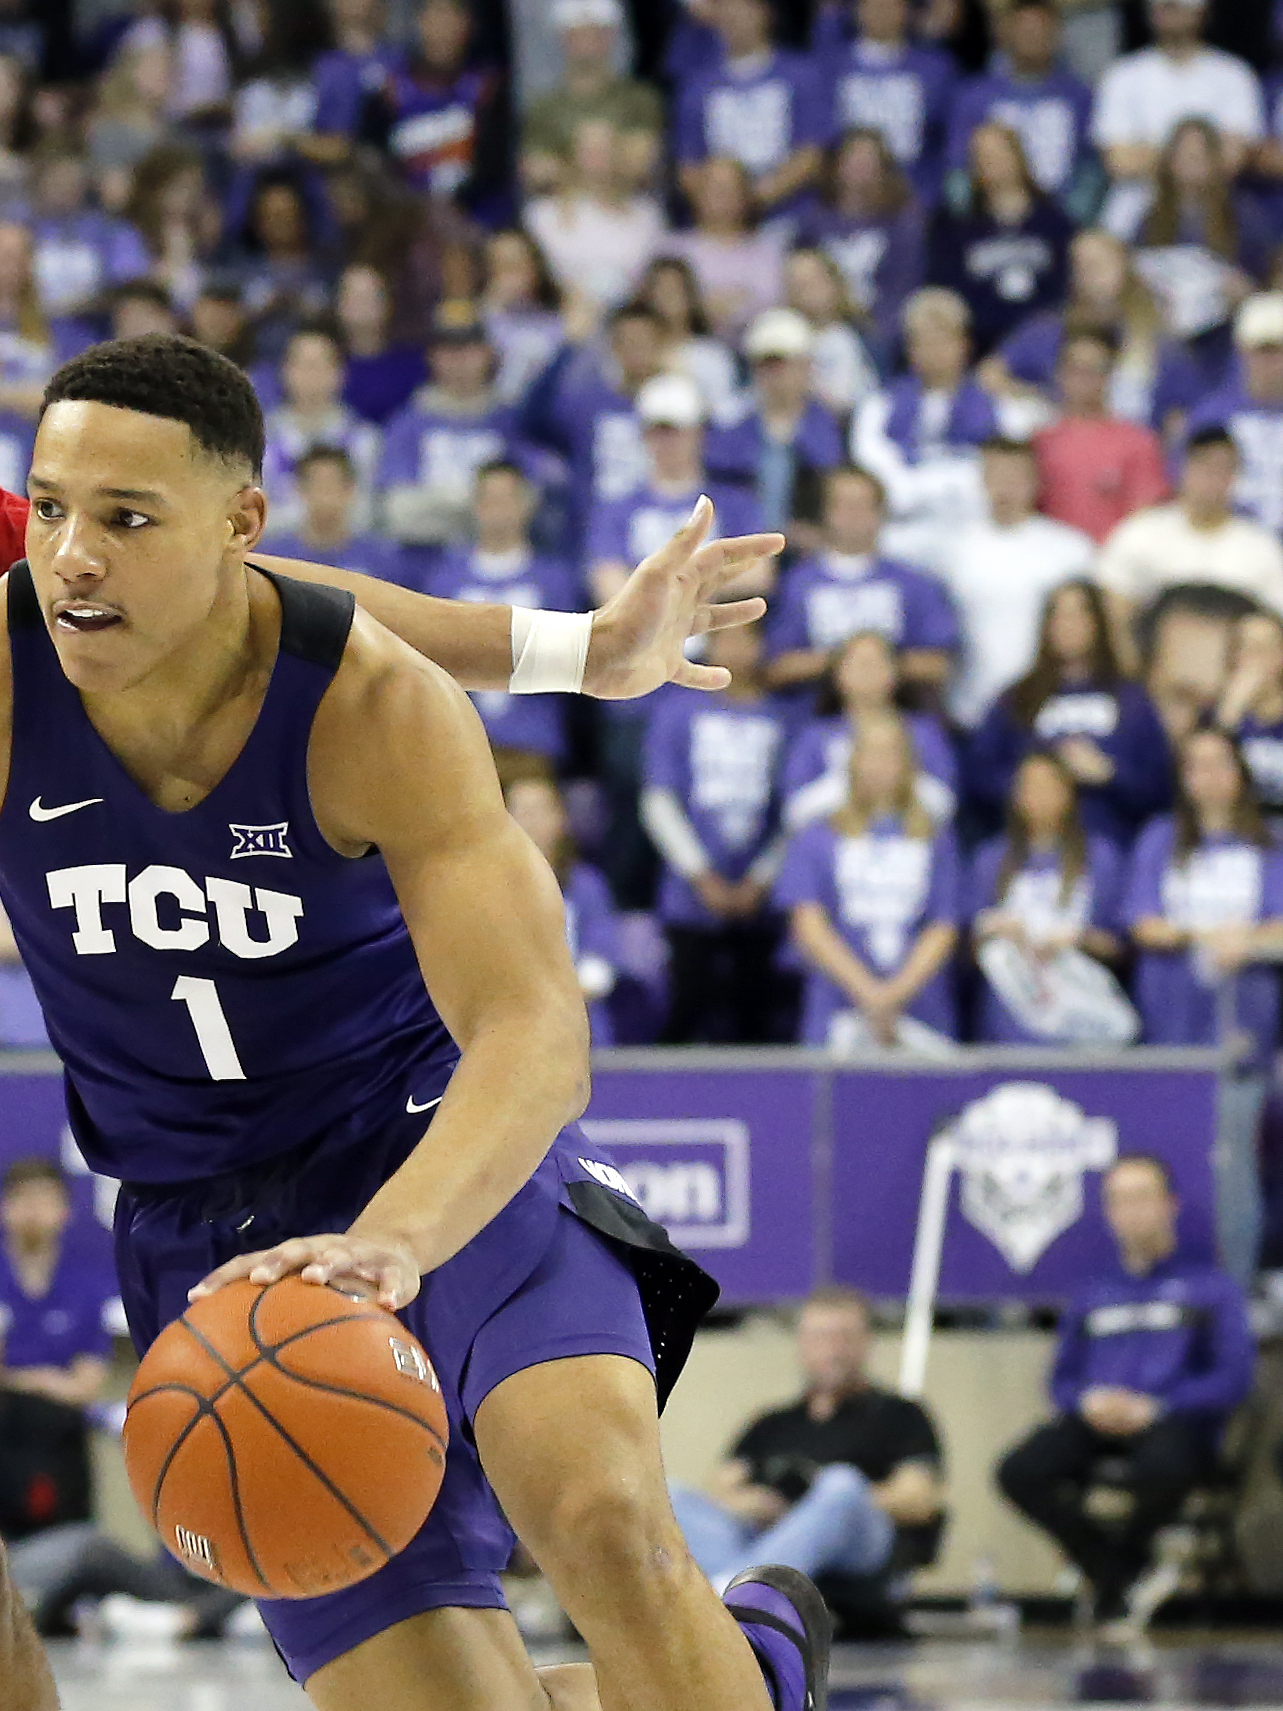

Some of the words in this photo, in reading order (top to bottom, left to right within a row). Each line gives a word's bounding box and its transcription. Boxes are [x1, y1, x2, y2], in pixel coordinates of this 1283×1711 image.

[229, 822, 293, 859] XII
[45, 864, 304, 958] TCU
[171, 975, 247, 1080] 1
